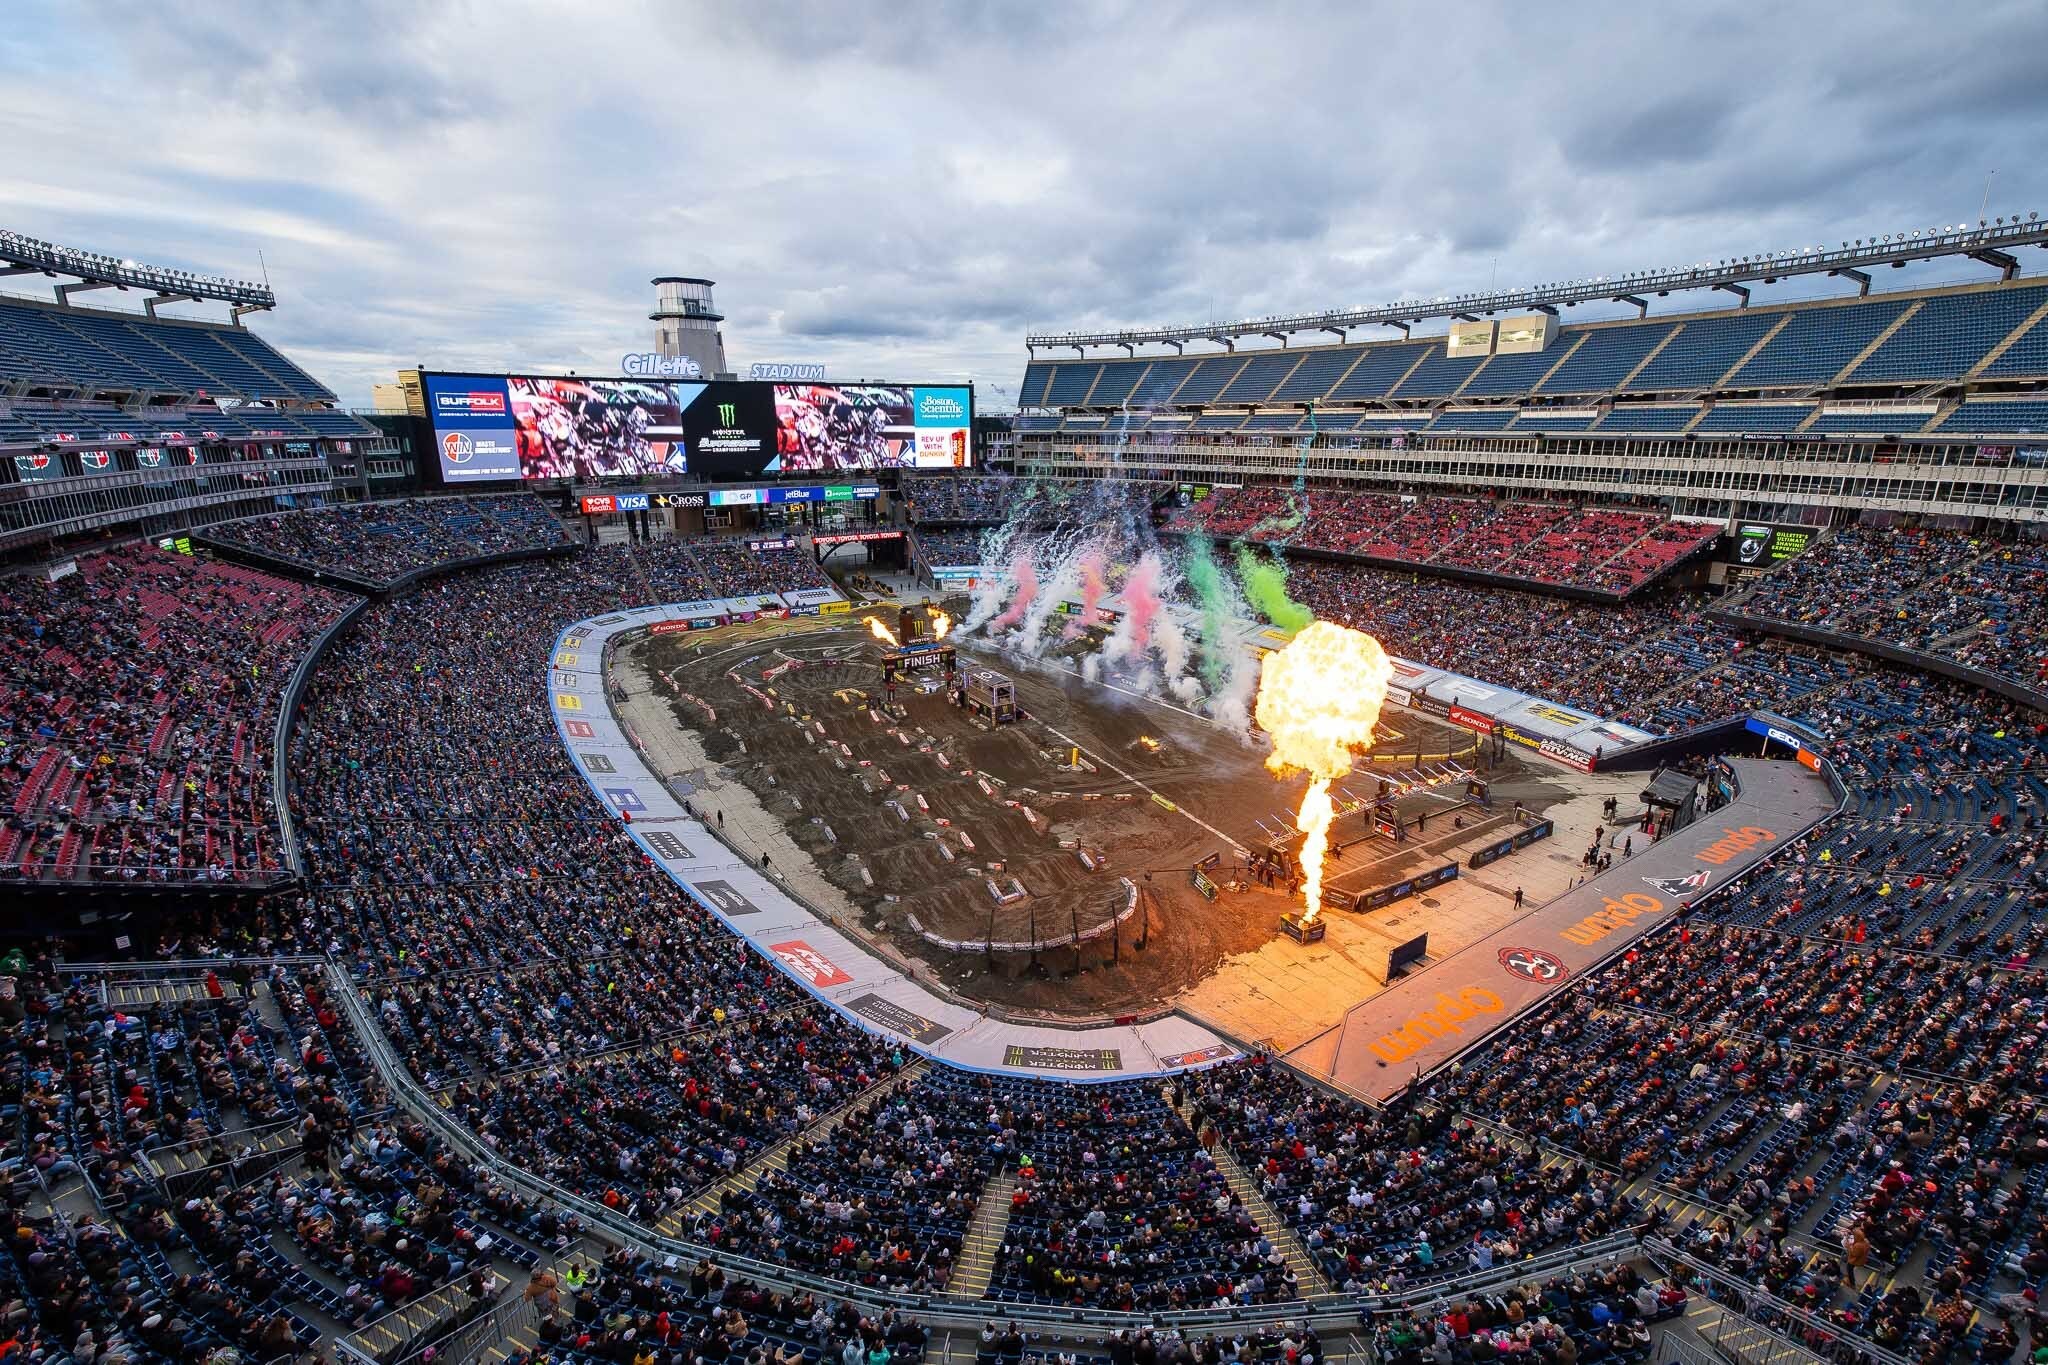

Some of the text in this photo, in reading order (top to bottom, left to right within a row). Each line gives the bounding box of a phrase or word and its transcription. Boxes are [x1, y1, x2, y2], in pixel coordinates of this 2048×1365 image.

[622, 353, 699, 377] Gillette
[751, 363, 825, 379] STADIUM
[441, 397, 499, 406] SUFFOLK
[926, 396, 953, 406] Boston
[920, 402, 964, 413] Scientific
[445, 442, 470, 454] WIN
[594, 497, 610, 505] CVS
[785, 490, 809, 500] jetBlue
[619, 497, 648, 508] VISA
[815, 536, 836, 544] TOYOTA
[860, 533, 880, 541] TOYOTA
[880, 531, 901, 539] TOYOTA
[1776, 532, 1809, 540] GILLETTE'S
[790, 606, 820, 615] FALKEN
[660, 623, 688, 632] HONDA
[904, 653, 940, 668] FINISH
[1421, 704, 1449, 717] COMMISSION
[1434, 703, 1450, 713] SPORTS
[1460, 715, 1491, 731] HONDA
[1503, 730, 1541, 749] alpinestars
[1767, 728, 1801, 749] GEICO
[1697, 825, 1778, 866] Optum
[1559, 893, 1664, 948] Optum
[1368, 986, 1505, 1065] Optum
[1028, 1060, 1097, 1070] MONSTER
